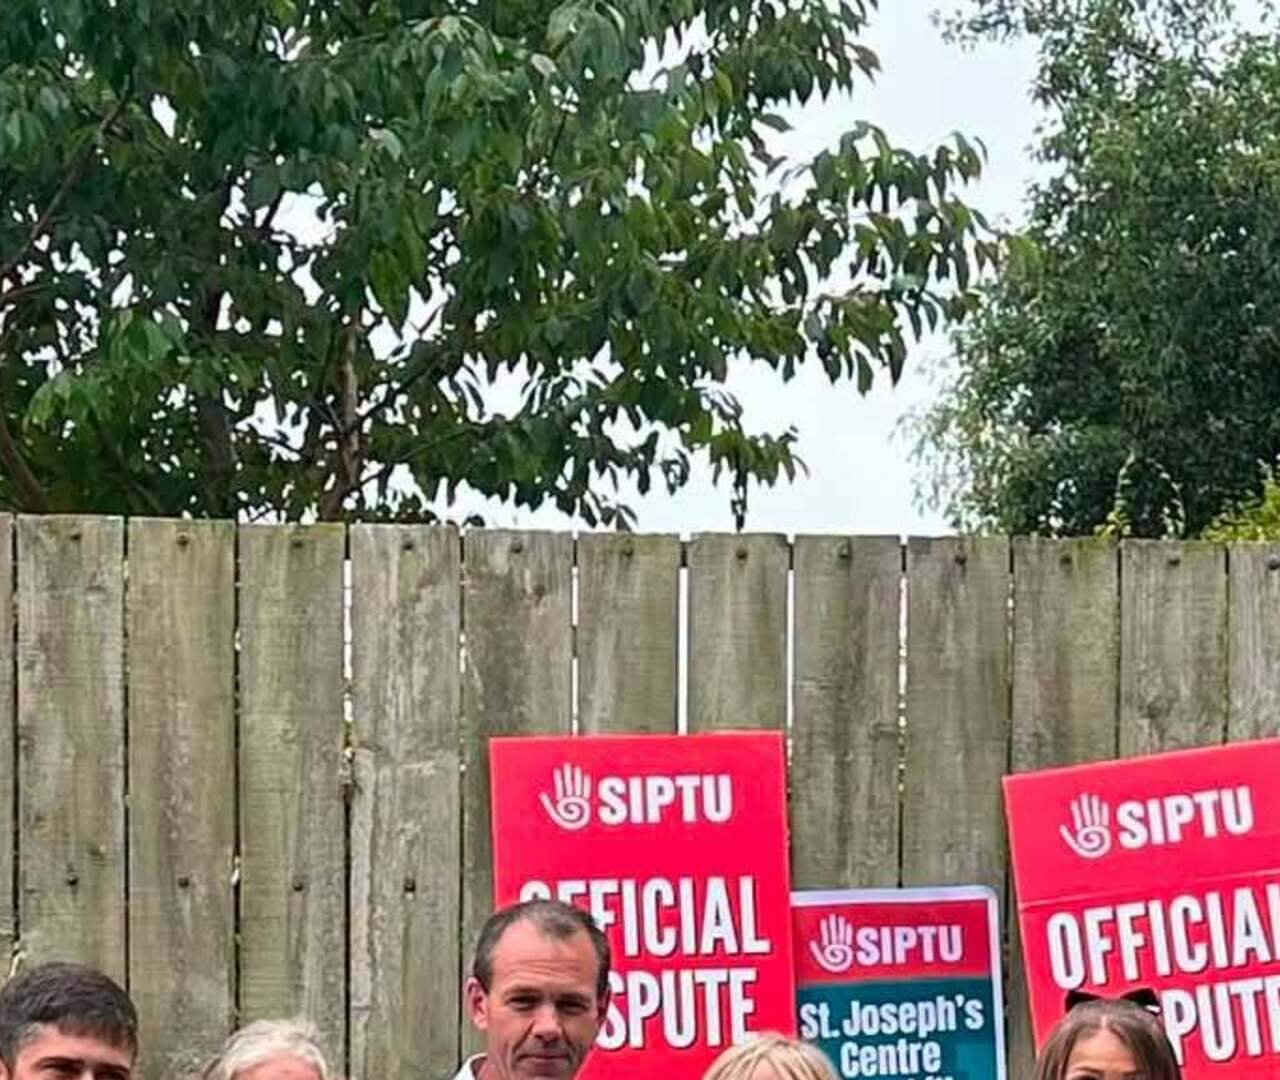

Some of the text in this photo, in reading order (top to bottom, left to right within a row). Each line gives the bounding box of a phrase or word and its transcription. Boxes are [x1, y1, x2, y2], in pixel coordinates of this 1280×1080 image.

[598, 774, 733, 825] SIPTU
[1115, 786, 1254, 849] SIPTU
[519, 876, 771, 956] FICIAL
[856, 925, 963, 965] SIPTU
[594, 967, 760, 1050] SPUTE
[800, 994, 984, 1039] St. Joseph's
[840, 1038, 941, 1077] Centre
